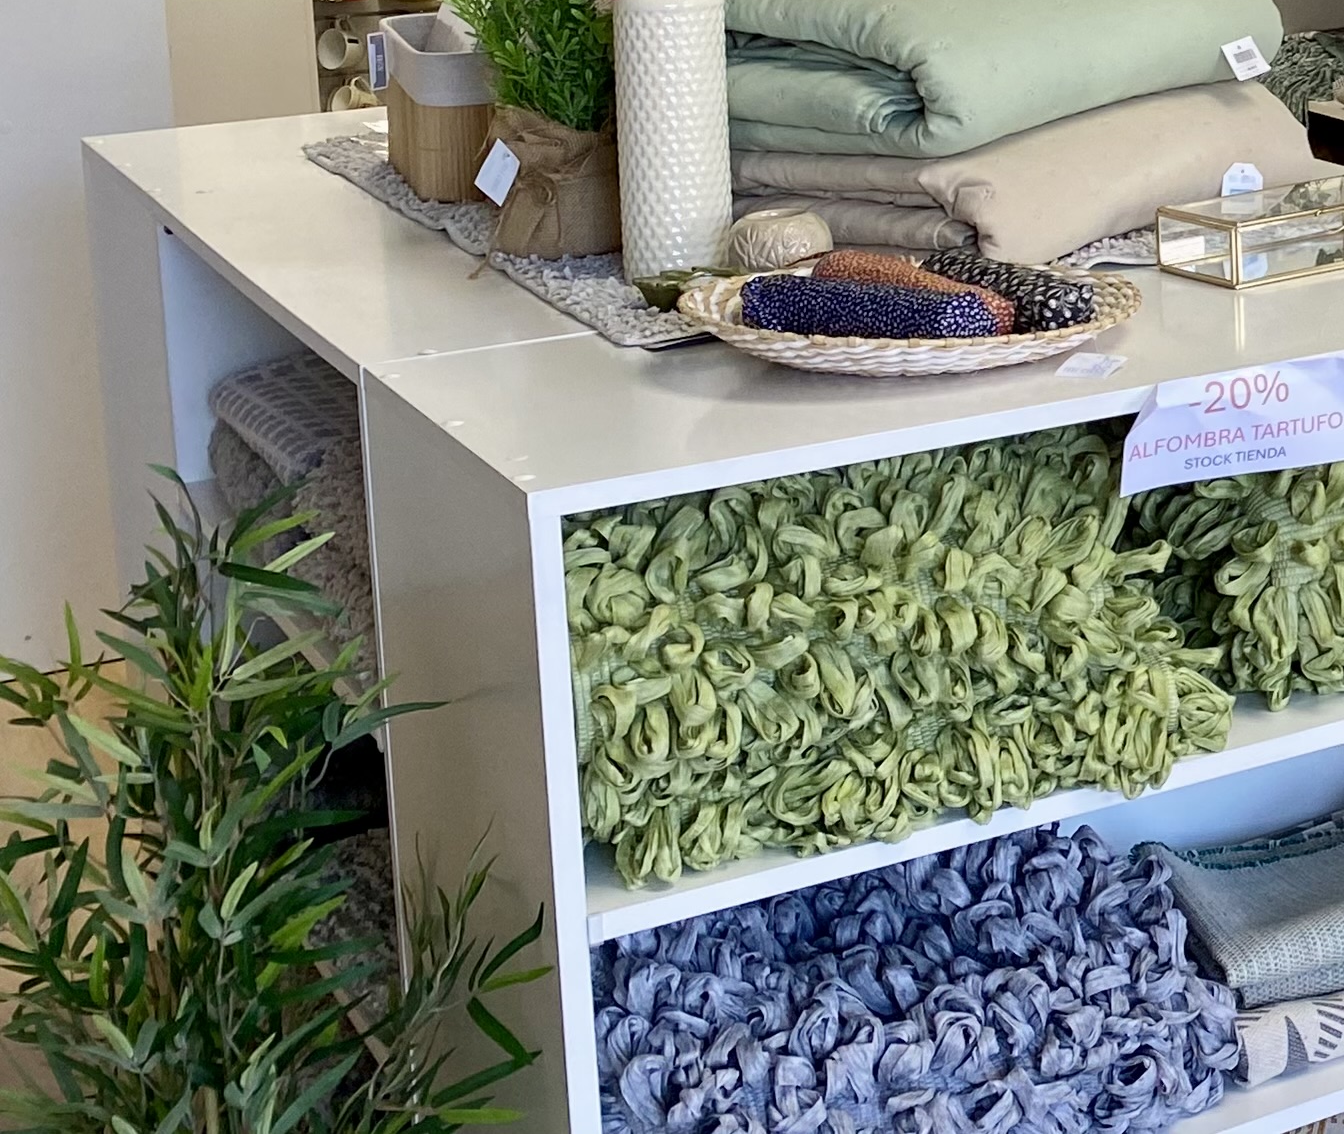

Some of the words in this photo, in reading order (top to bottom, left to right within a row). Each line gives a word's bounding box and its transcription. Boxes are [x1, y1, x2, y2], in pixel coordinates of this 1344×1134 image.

[1188, 370, 1290, 415] -20%
[1128, 425, 1246, 463] ALFOMBRA
[1251, 411, 1344, 441] TARTUFO
[1184, 453, 1232, 471] STOCK
[1235, 445, 1287, 463] TIENDA
